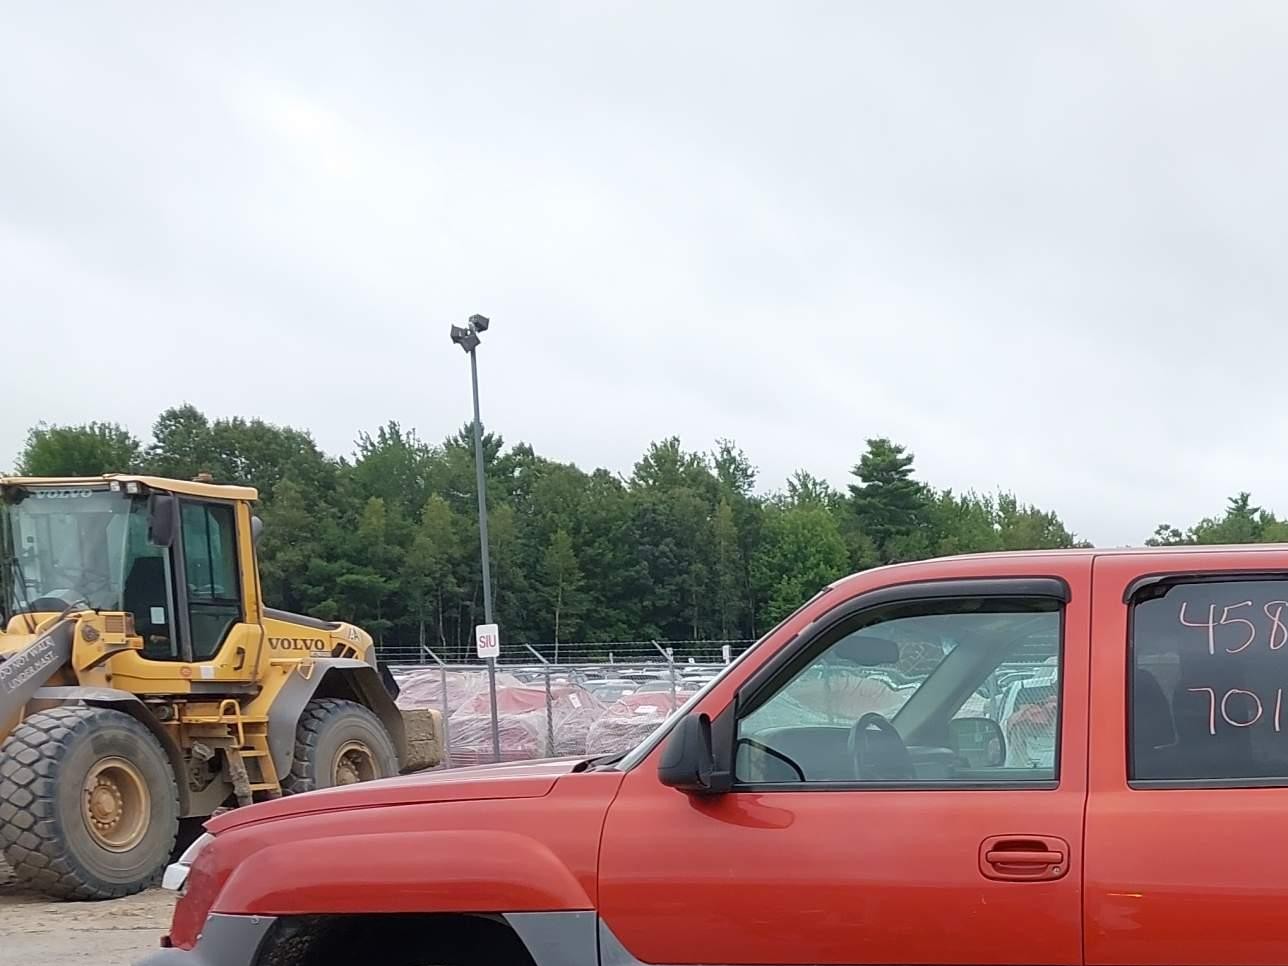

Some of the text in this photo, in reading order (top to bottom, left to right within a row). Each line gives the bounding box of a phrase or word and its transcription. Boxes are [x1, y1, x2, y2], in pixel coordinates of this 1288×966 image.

[36, 489, 92, 499] VOLVO
[268, 637, 325, 651] VOLVO
[480, 635, 497, 648] SIU
